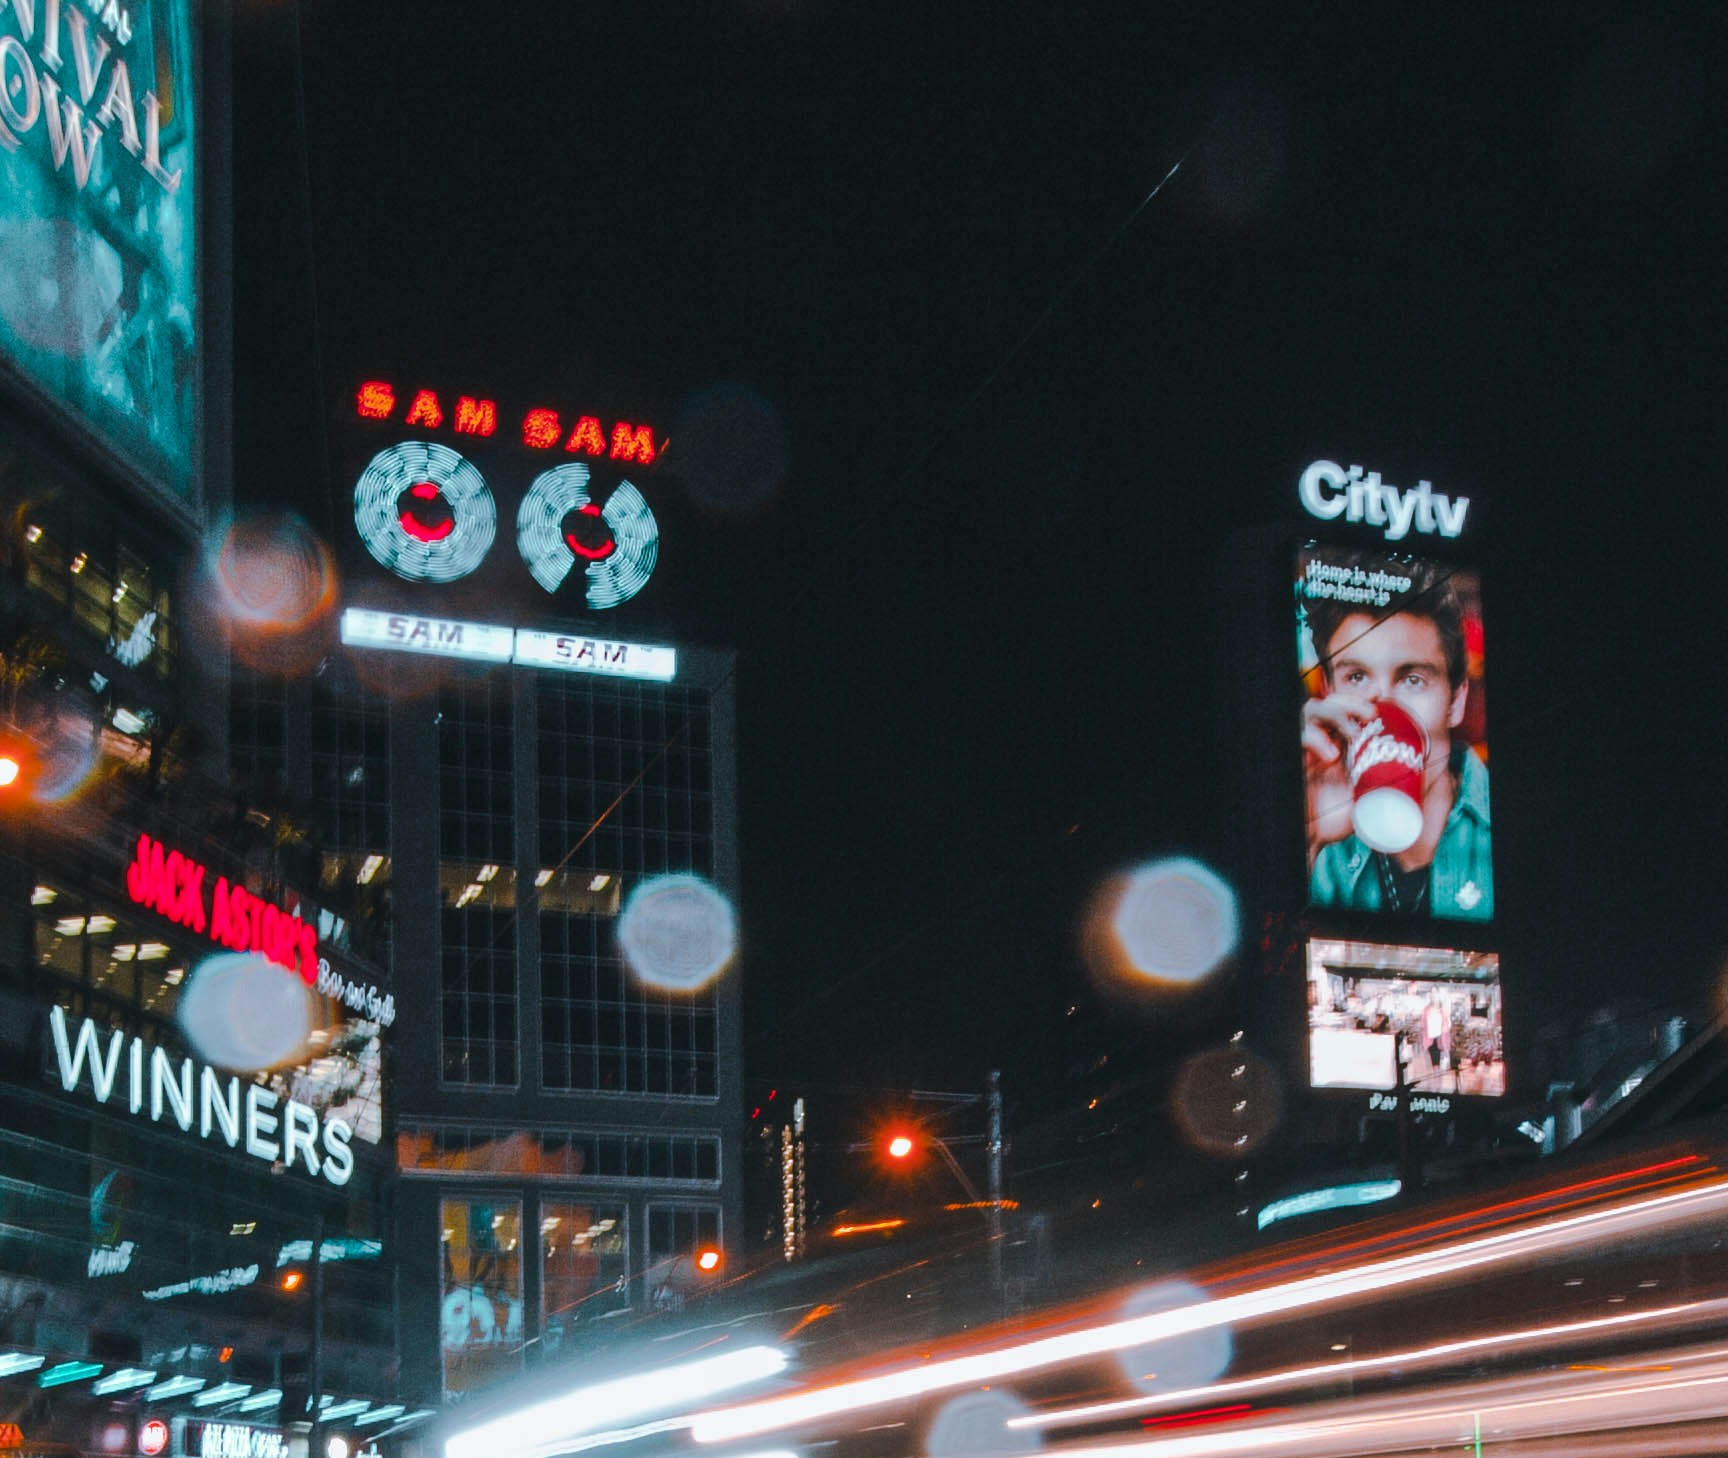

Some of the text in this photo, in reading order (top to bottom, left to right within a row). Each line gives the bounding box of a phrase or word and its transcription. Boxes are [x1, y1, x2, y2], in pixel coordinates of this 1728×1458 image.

[356, 380, 656, 464] SAM SAM
[1298, 459, 1470, 541] Citytv
[1306, 559, 1352, 584] Home
[387, 615, 465, 645] SAM
[555, 636, 629, 665] SAM
[127, 832, 319, 987] JACK ASTOR'S
[50, 1004, 354, 1186] WINNERS
